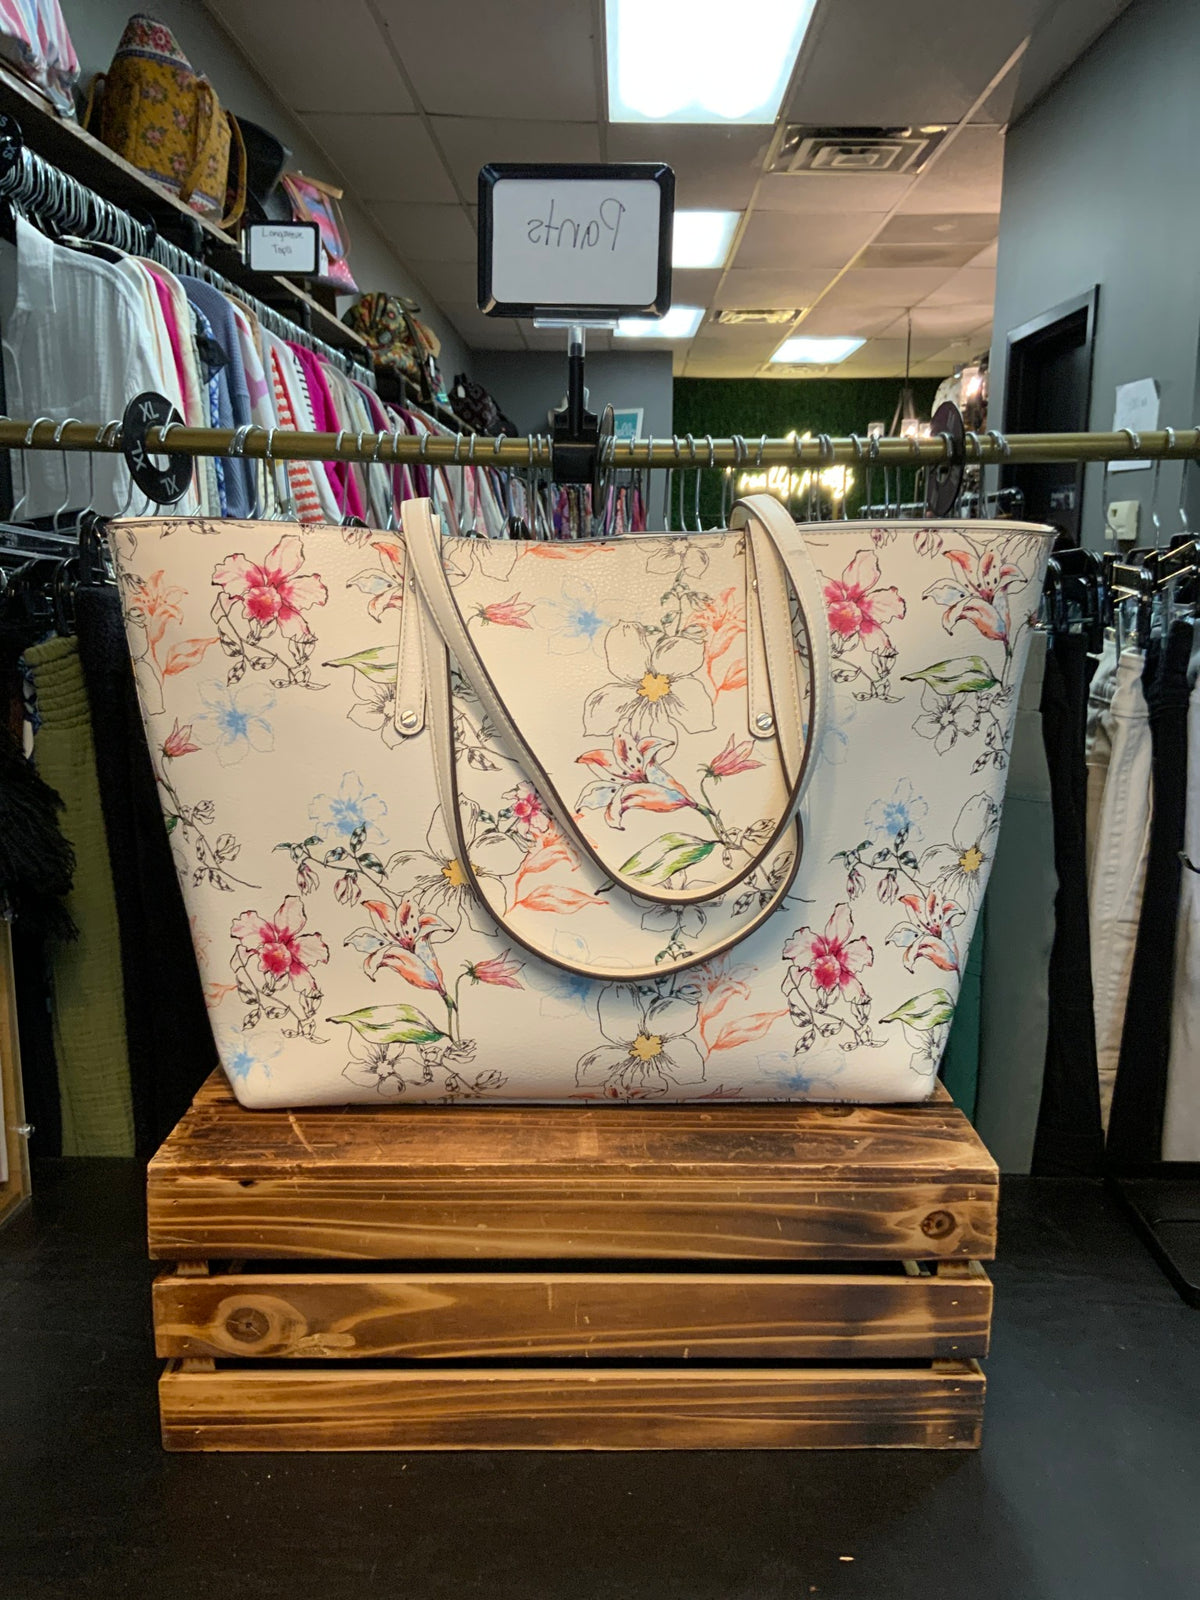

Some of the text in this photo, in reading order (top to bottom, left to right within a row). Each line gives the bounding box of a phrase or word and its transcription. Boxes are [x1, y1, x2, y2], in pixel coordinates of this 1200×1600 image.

[2, 142, 17, 160] XS
[138, 401, 160, 423] XL
[131, 440, 147, 472] XL
[160, 474, 180, 496] XL
